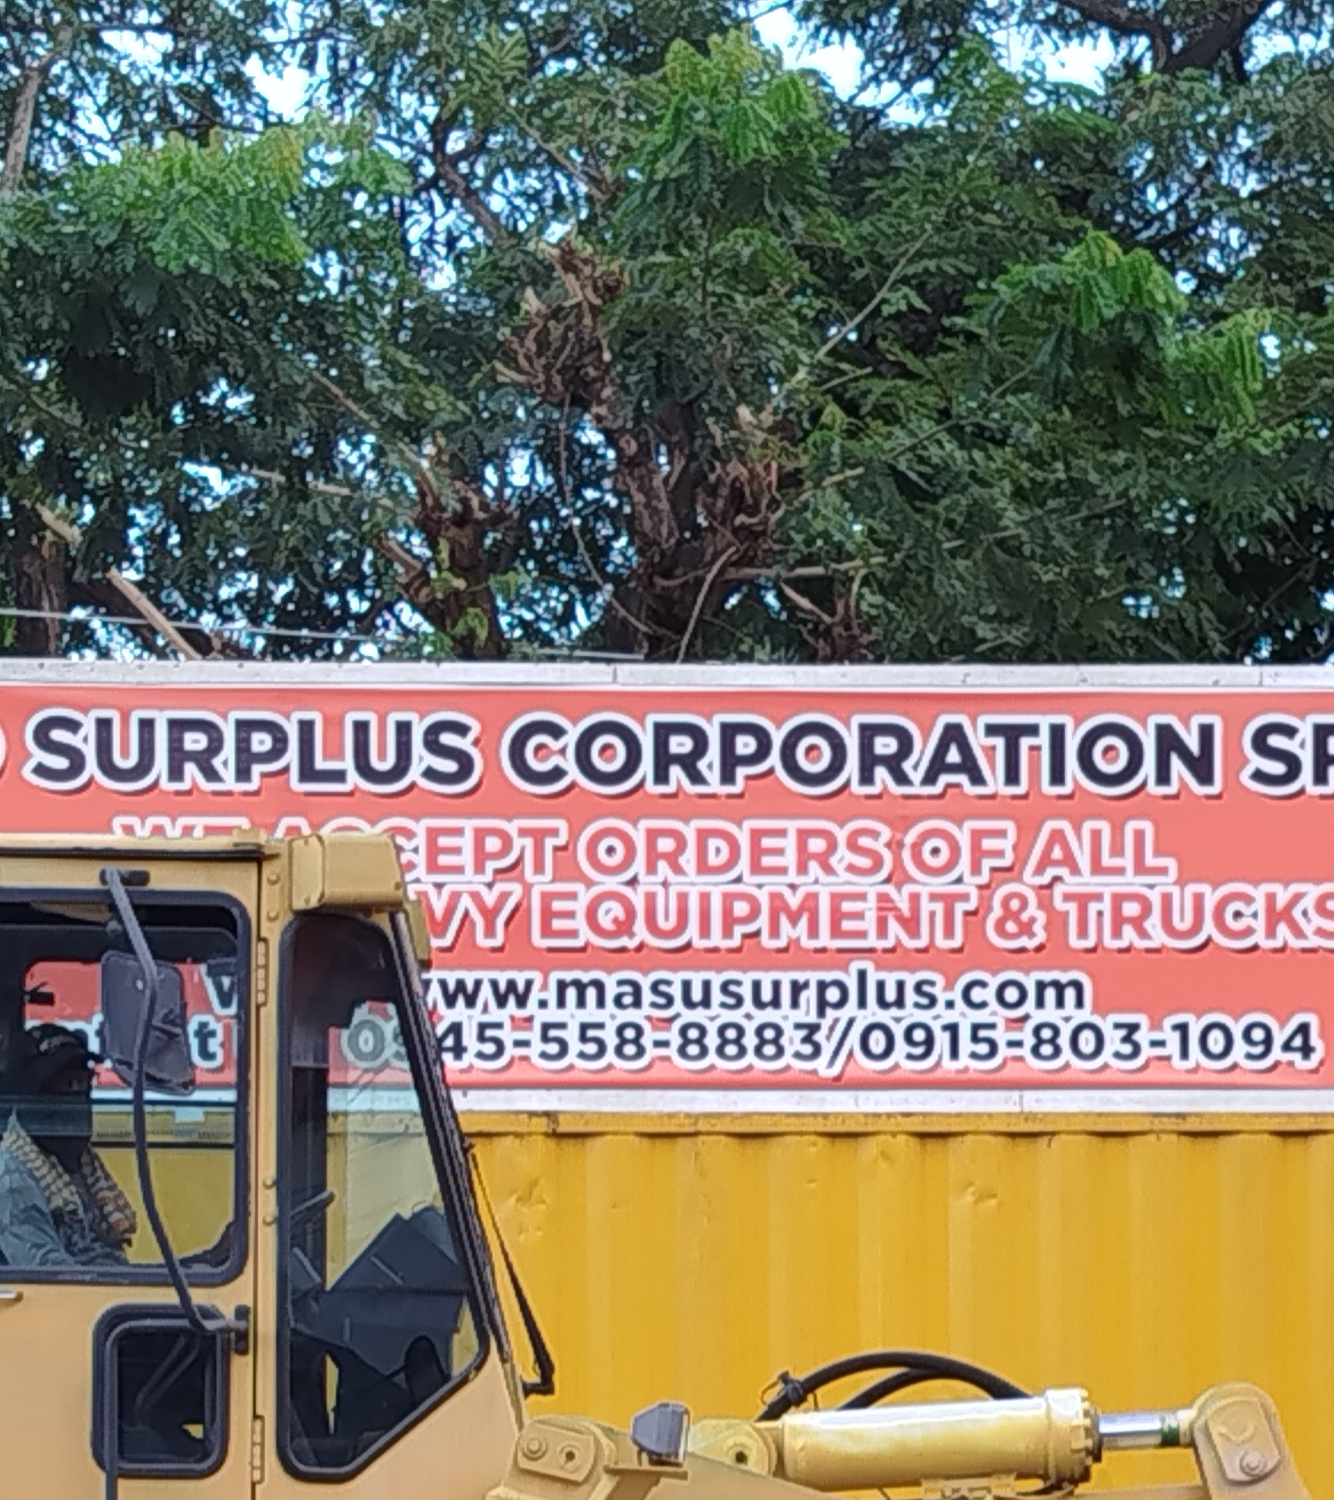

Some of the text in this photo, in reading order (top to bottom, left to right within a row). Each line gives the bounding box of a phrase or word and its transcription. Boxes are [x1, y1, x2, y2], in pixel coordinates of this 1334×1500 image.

[27, 711, 478, 788] SURPLUS
[505, 716, 1217, 790] CORPORATION
[586, 824, 889, 878] ORDERS
[908, 824, 1012, 878] OF
[1030, 825, 1170, 879] ALL
[538, 889, 971, 942] EQUIPMENT
[992, 889, 1043, 943] &
[421, 966, 1088, 1021] ww.masusurplus.com
